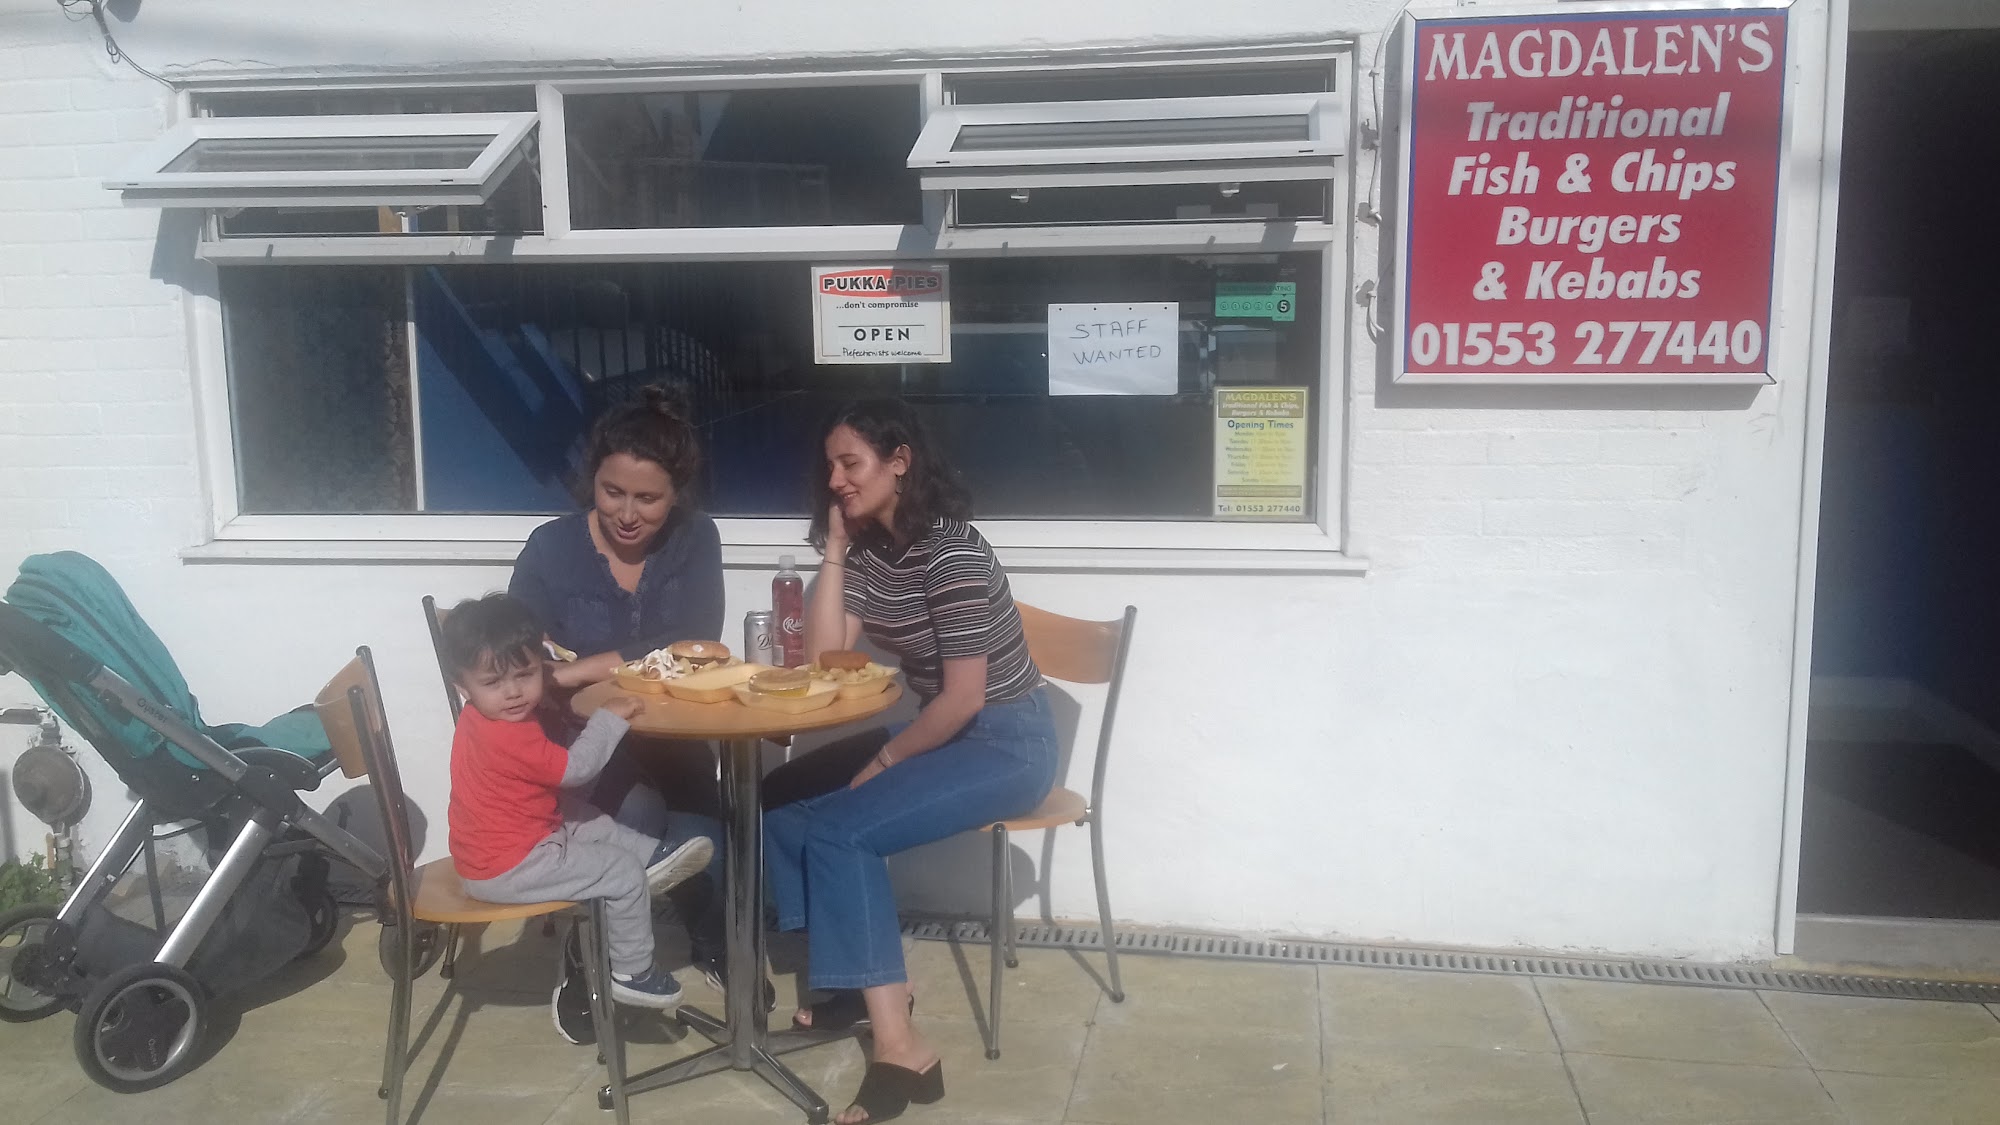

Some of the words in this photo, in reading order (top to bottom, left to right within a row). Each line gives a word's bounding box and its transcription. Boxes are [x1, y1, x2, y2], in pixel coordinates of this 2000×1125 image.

[1424, 20, 1774, 81] MAGDALEN'S
[1466, 91, 1732, 142] Traditional
[1447, 152, 1541, 196] Fish
[1556, 152, 1593, 194] &
[1610, 147, 1738, 200] Chips
[1495, 206, 1683, 254] Burgers
[1472, 261, 1508, 301] &
[1524, 256, 1702, 300] Kebabs
[867, 301, 919, 309] compromise
[1280, 301, 1288, 312] 5
[853, 327, 910, 341] OPEN
[1069, 319, 1149, 339] STAFF
[1411, 322, 1556, 366] 01553
[1573, 320, 1763, 365] 277440
[1073, 345, 1162, 365] WANTED
[1228, 420, 1265, 430] Opening
[1267, 420, 1294, 429] Times
